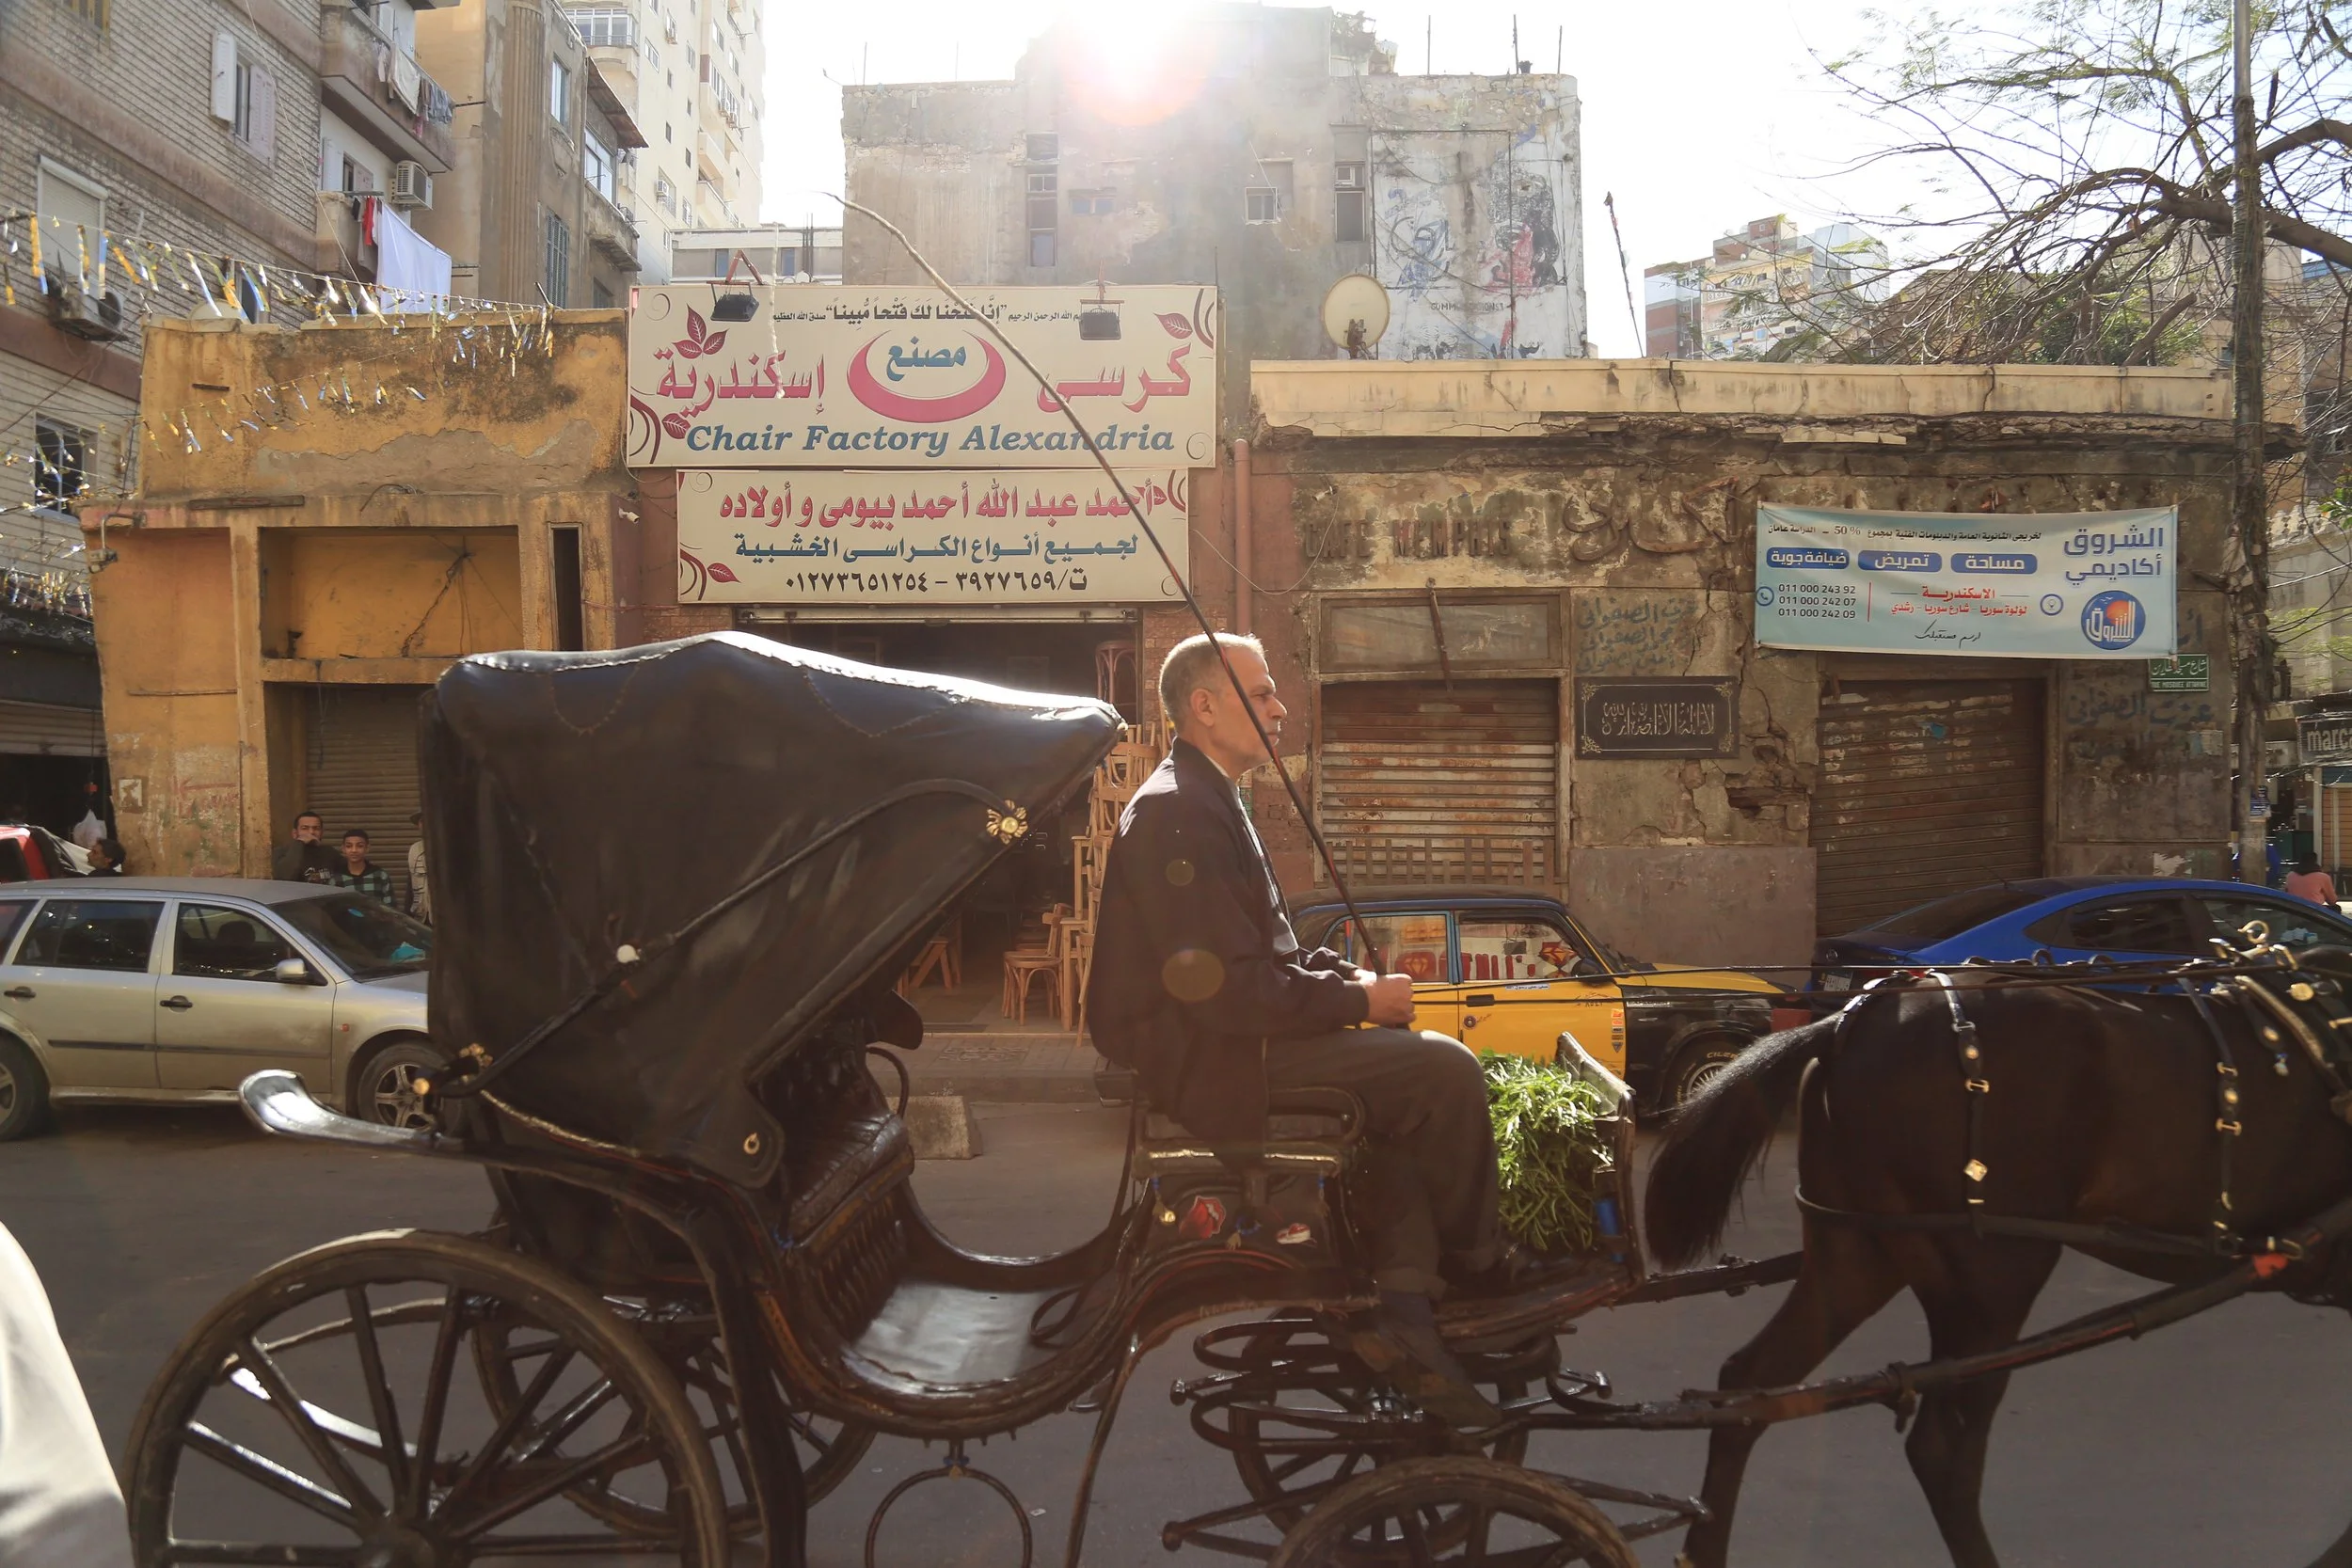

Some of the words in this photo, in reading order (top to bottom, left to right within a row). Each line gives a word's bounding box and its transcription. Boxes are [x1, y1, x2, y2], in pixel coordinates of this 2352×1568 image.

[885, 335, 967, 382] مصنع
[653, 346, 826, 419] إسكندرية
[686, 423, 793, 451] Chair
[802, 424, 949, 458] Factory
[719, 480, 792, 529] أولاده
[794, 496, 814, 529] و
[900, 480, 969, 520] أحمد
[975, 477, 1019, 518] الله
[1025, 487, 1079, 528] عبد
[733, 532, 839, 564] الخشبية
[970, 531, 1041, 564] أنواع
[1043, 532, 1139, 565] لجميع
[1391, 517, 1513, 558] MEMPHIS
[2063, 524, 2164, 556] الشروق
[1771, 550, 1804, 566] جوية
[1804, 551, 1847, 566] ضيافة
[1874, 552, 1931, 570] تمريض
[1964, 555, 2026, 571] مساحة
[2065, 553, 2162, 586] أكاديمي
[1778, 583, 1797, 593] 011
[1800, 584, 1820, 594] 000
[1821, 585, 1841, 594] 243
[1842, 585, 1856, 594] 92
[1778, 595, 1798, 605] 011
[1800, 596, 1820, 605] 000
[1821, 596, 1842, 606] 242
[1843, 597, 1857, 607] 07
[1778, 608, 1797, 617] 011
[1800, 609, 1820, 617] 000
[1820, 609, 1841, 618] 242
[1842, 610, 1856, 619] 09
[2189, 658, 2207, 675] شارع
